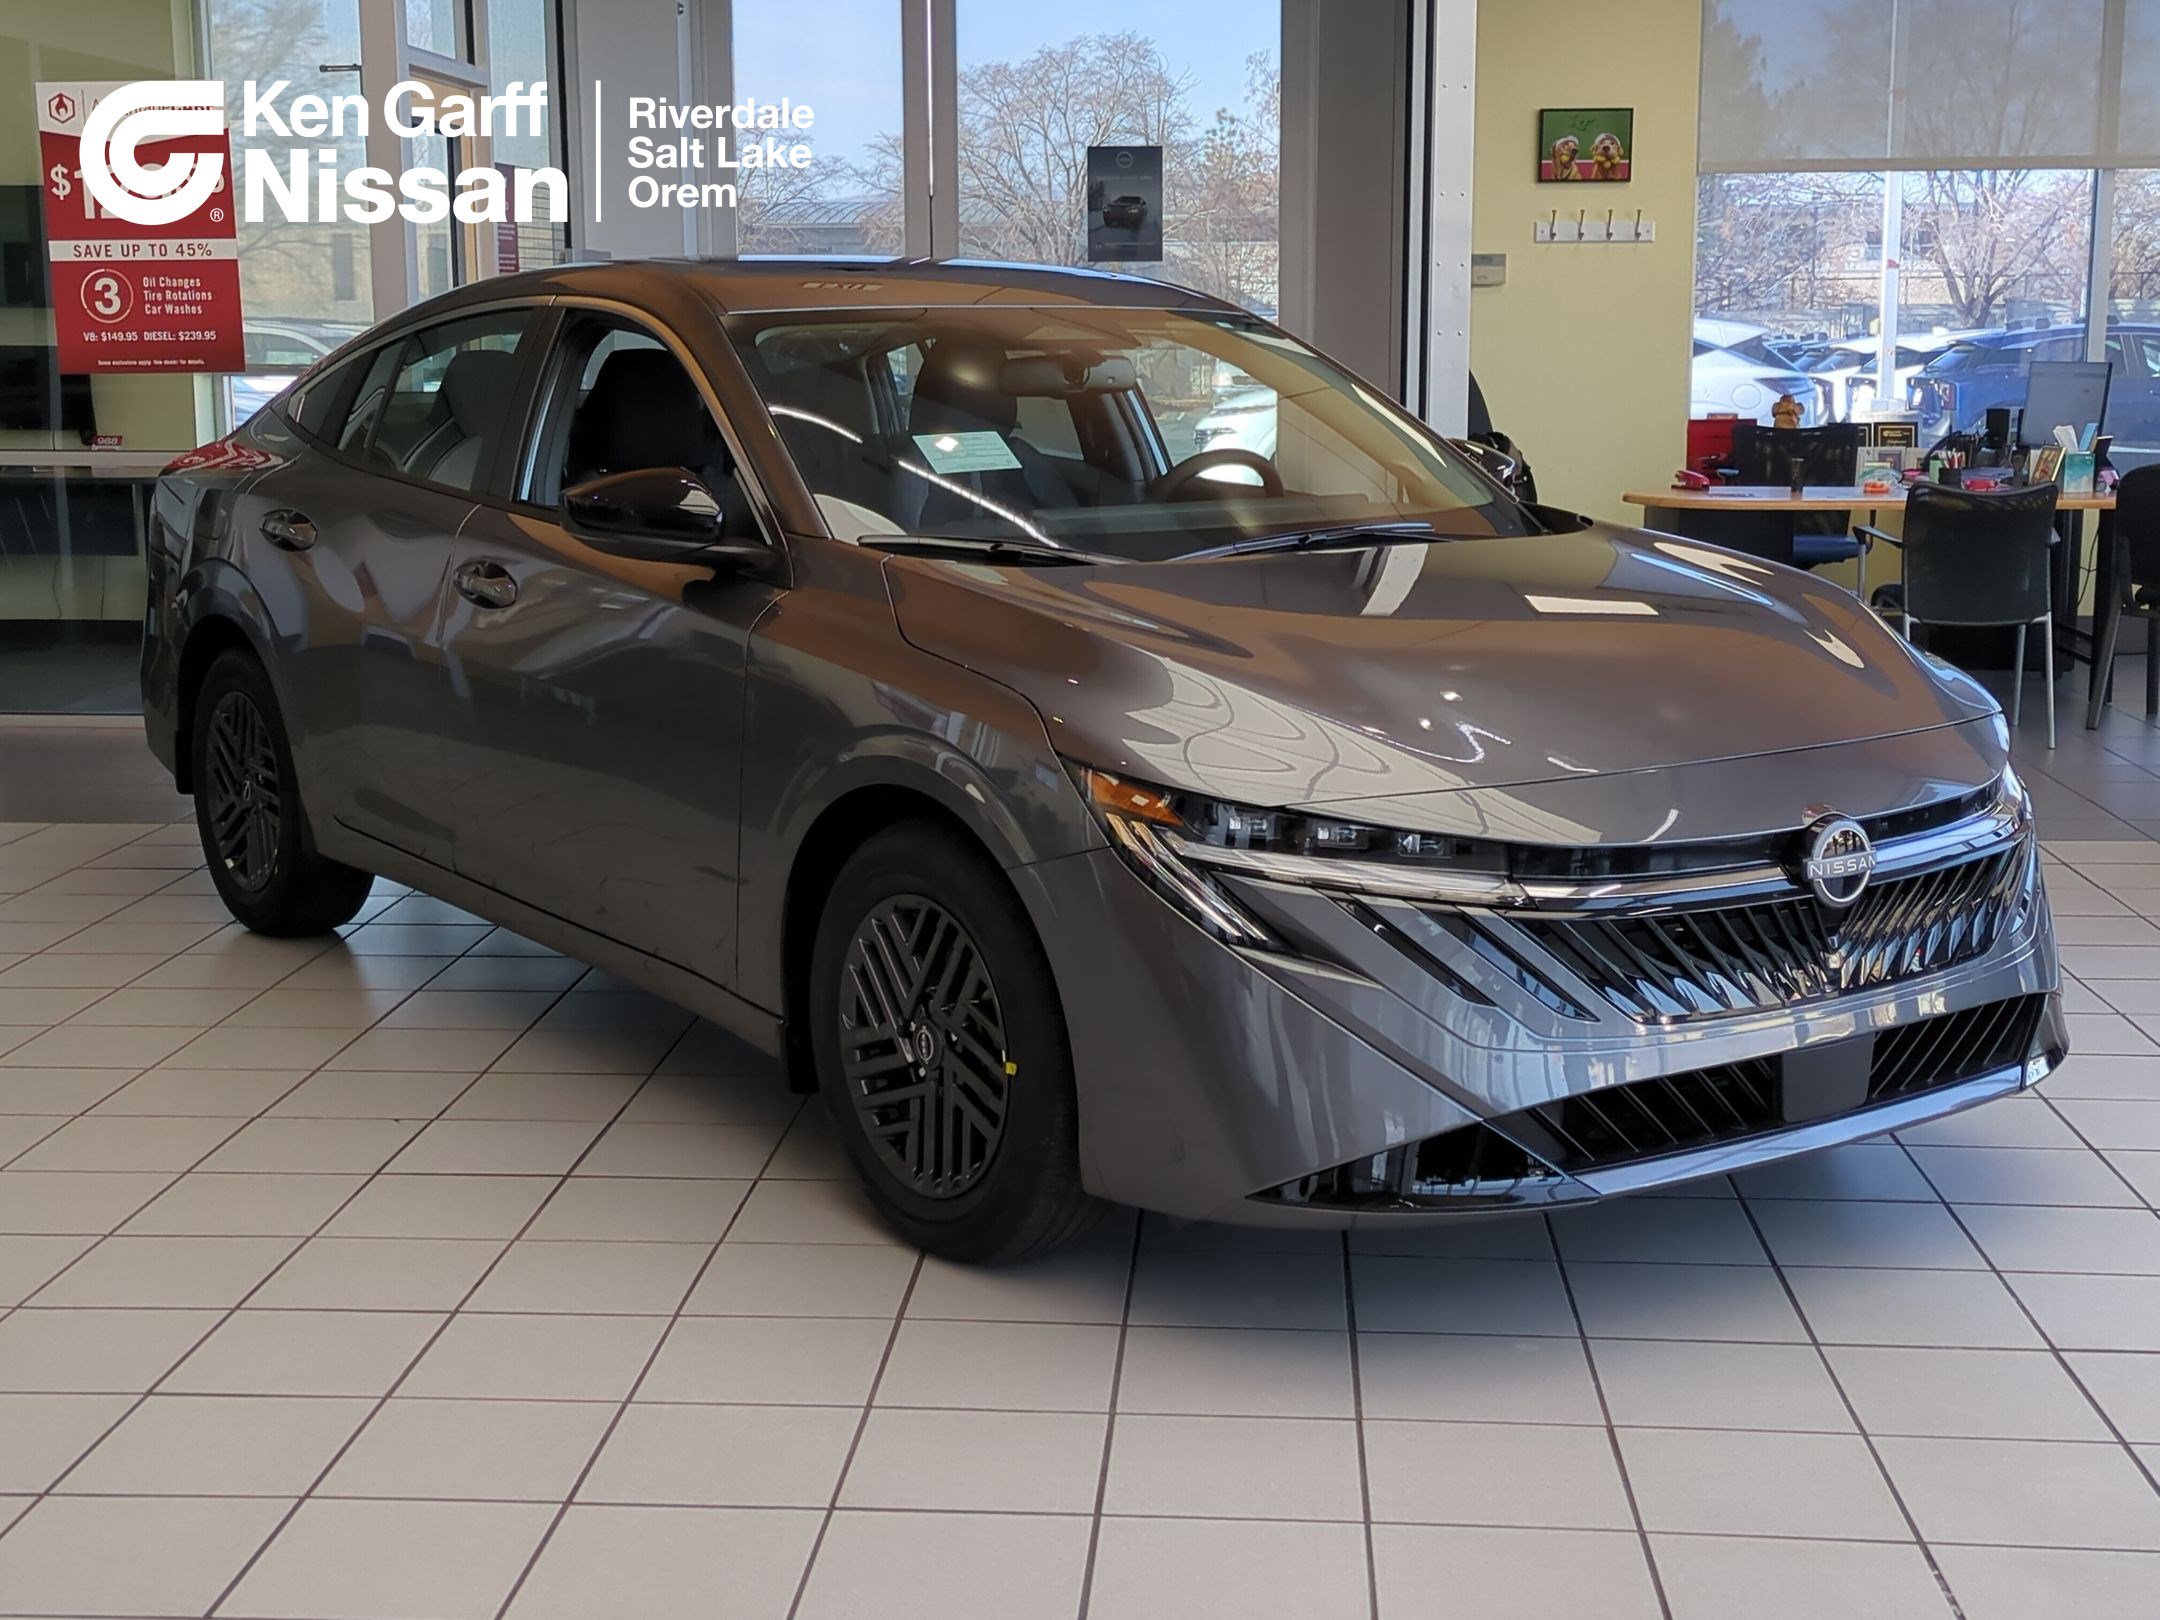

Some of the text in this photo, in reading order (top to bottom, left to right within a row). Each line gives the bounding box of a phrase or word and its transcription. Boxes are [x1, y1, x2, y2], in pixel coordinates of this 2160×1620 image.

[73, 243, 212, 258] SAVE UP TO 45%
[143, 277, 201, 289] Oil Changes
[94, 277, 121, 315] 3
[144, 290, 213, 301] Tire Rotations
[145, 304, 203, 315] Car Washes
[83, 331, 217, 342] V8: $149.95 DIESEL: $239.95
[1809, 855, 1876, 877] NISSAN
